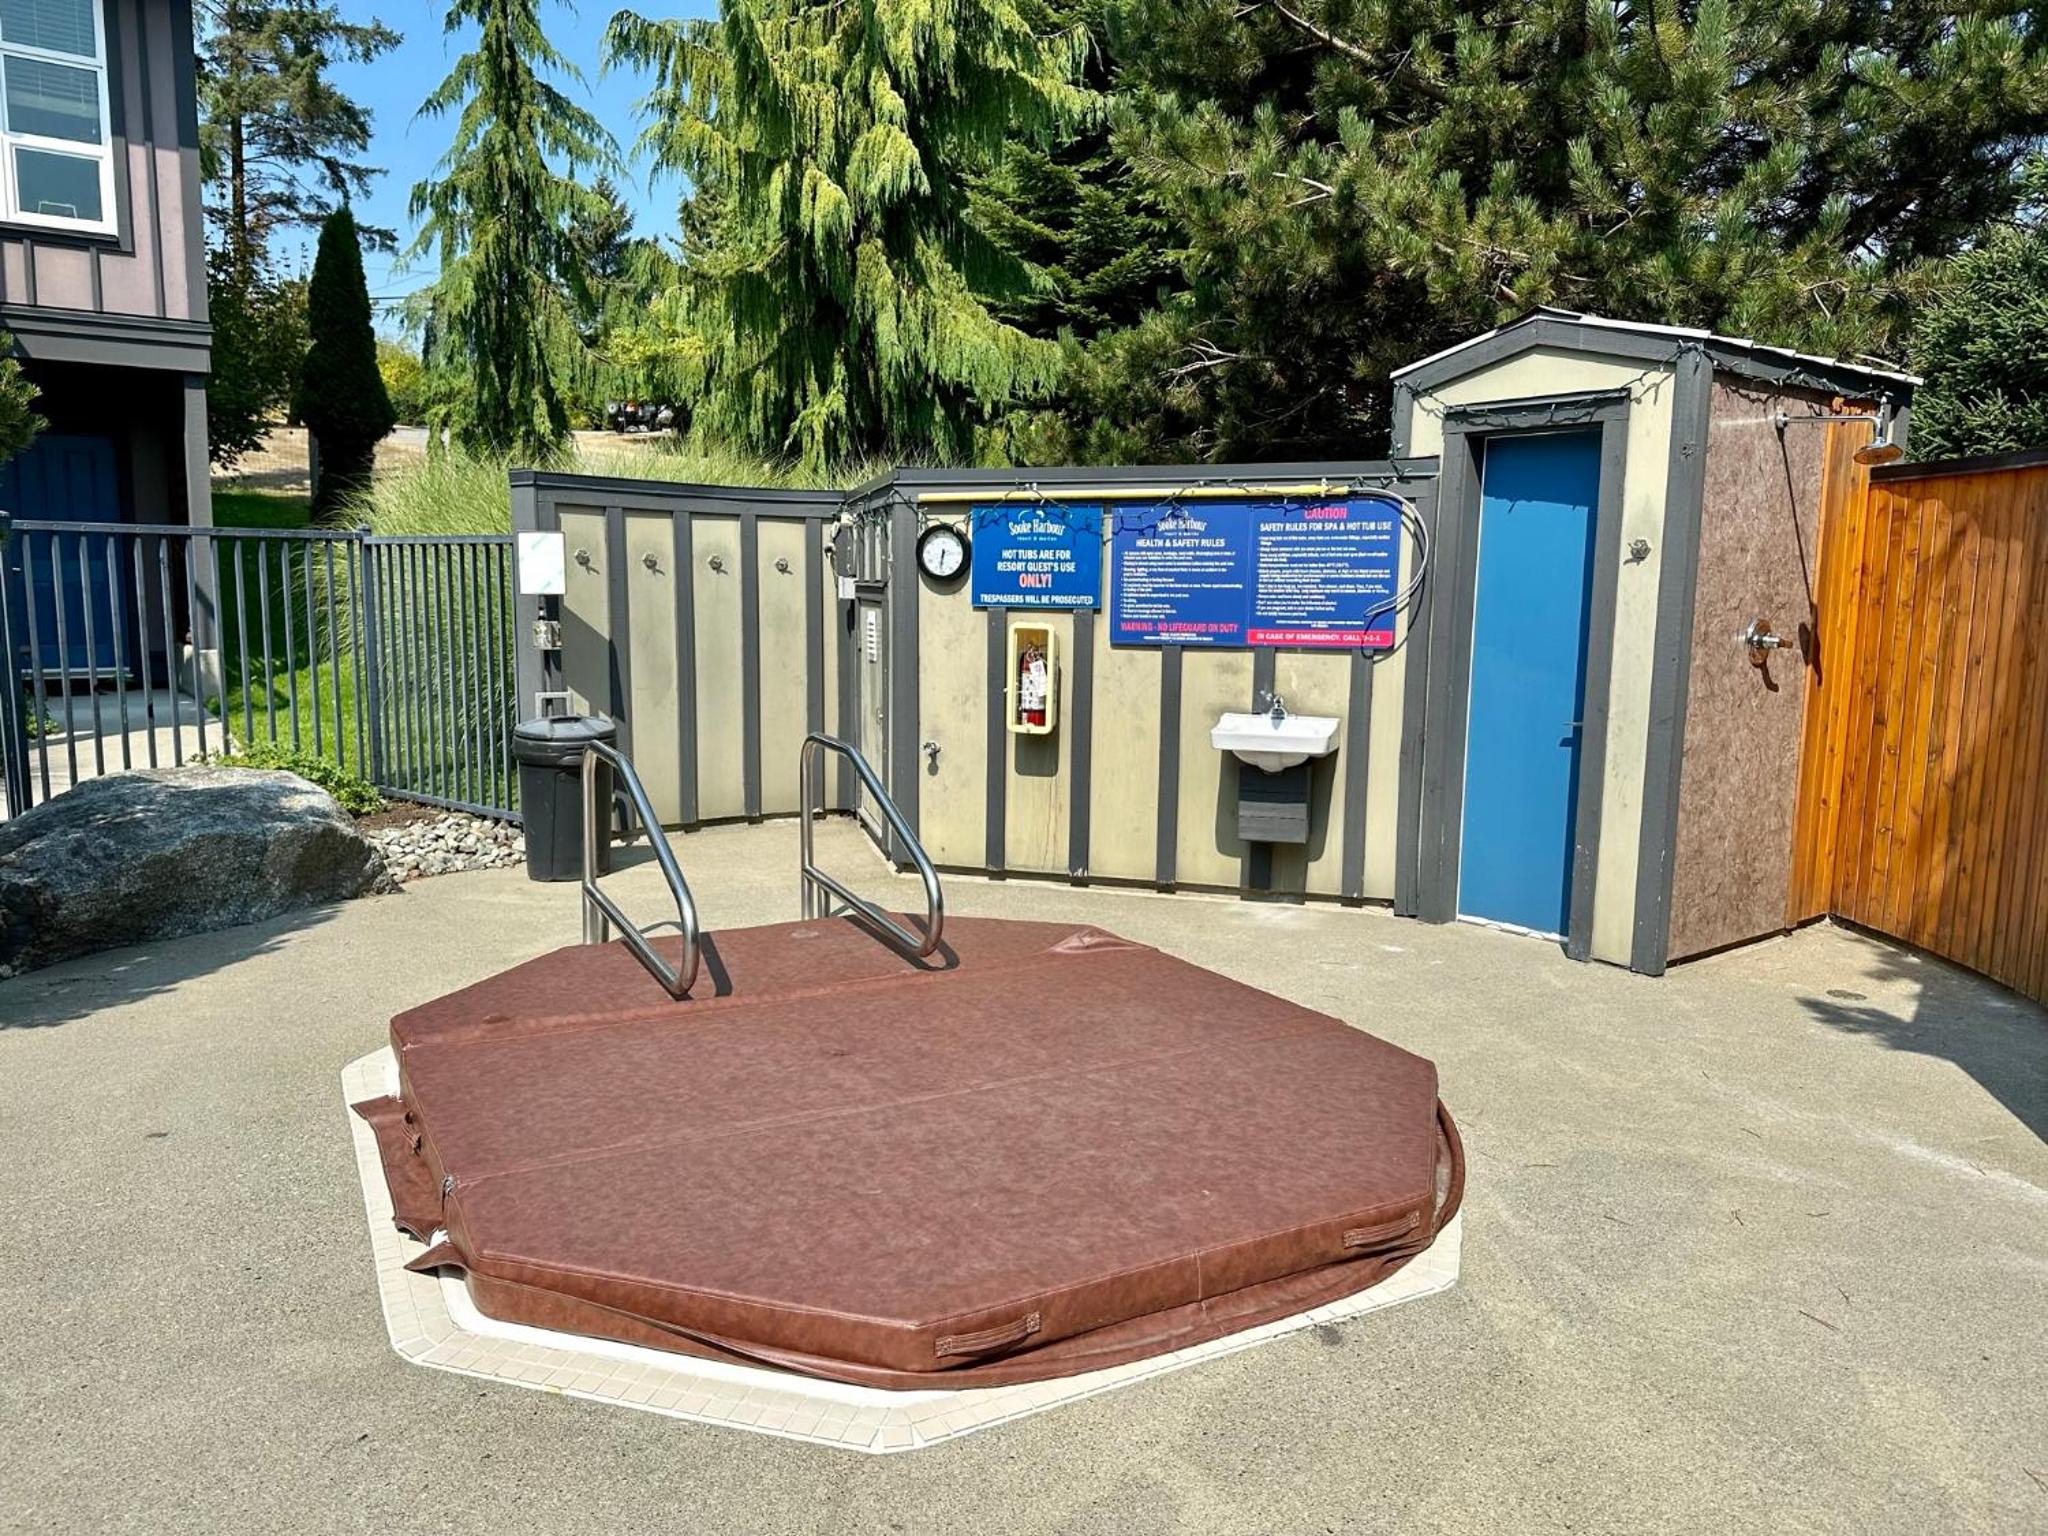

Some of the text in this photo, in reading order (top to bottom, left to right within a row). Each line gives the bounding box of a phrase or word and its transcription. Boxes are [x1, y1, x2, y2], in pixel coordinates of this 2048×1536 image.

[1303, 507, 1348, 519] CAUTION
[1008, 519, 1032, 536] Sooke
[1260, 521, 1392, 531] SAFETY RULES FOR SPA & HOT TUB USE
[1136, 538, 1225, 547] HEALTH & SAFETY RULES
[1002, 549, 1071, 560] HOT TUBS ARE FOR
[997, 561, 1076, 572] RESORT GUEST'S USE
[980, 594, 1093, 605] TRESPASSERS WILL BE PROSECUTED
[1120, 622, 1153, 631] WARNING
[1218, 623, 1238, 633] DUTY
